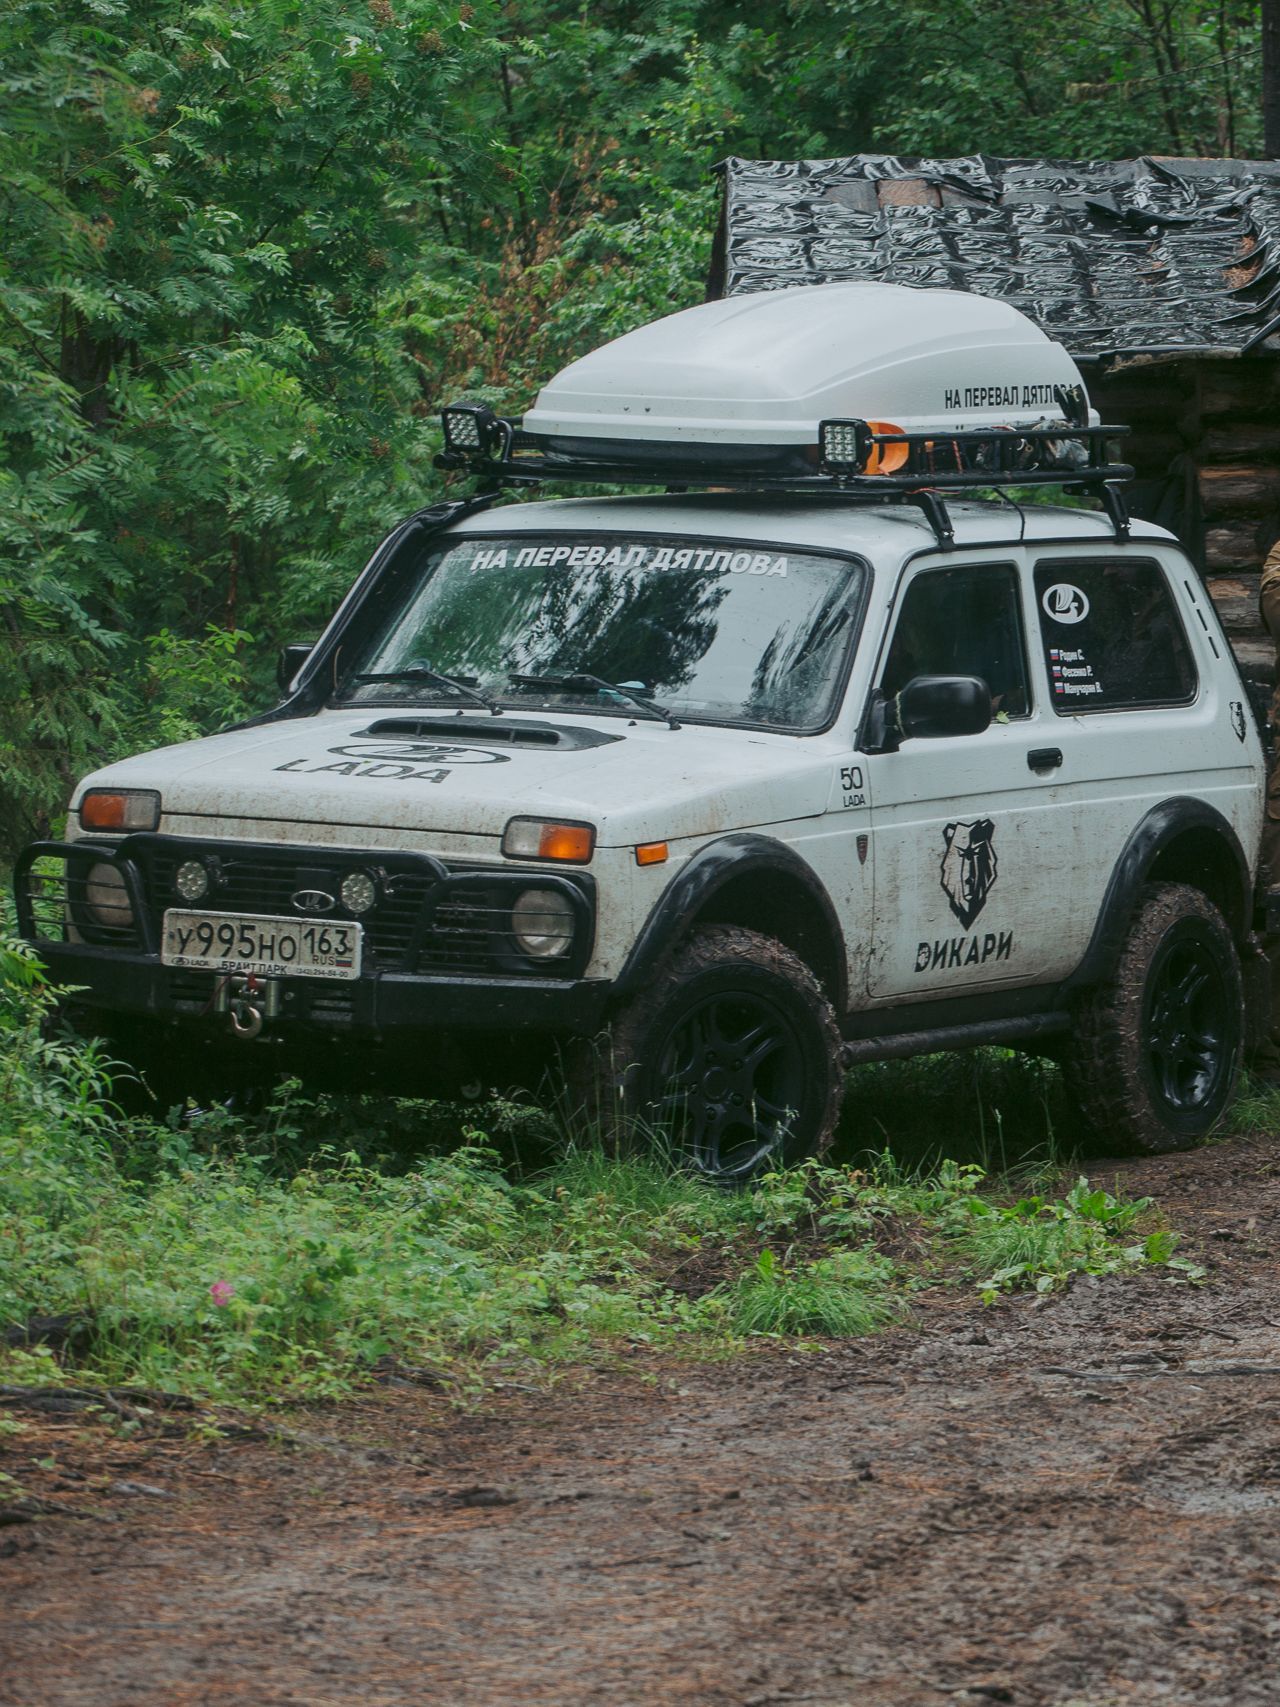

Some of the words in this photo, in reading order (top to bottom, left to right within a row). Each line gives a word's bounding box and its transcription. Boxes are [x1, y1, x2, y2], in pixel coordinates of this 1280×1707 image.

[945, 389, 961, 409] НА
[964, 386, 1019, 408] ПЕРЕВАЛ
[1022, 383, 1073, 408] ДЯТЛО
[470, 549, 508, 571] НА
[513, 546, 650, 568] ПЕРЕВАЛ
[647, 548, 789, 578] ДЯТЛОВА
[272, 759, 453, 784] LADA
[840, 766, 864, 791] 50
[843, 793, 866, 808] LADA
[303, 927, 349, 955] 163
[259, 963, 288, 975] ПАРК
[312, 955, 336, 966] RUS
